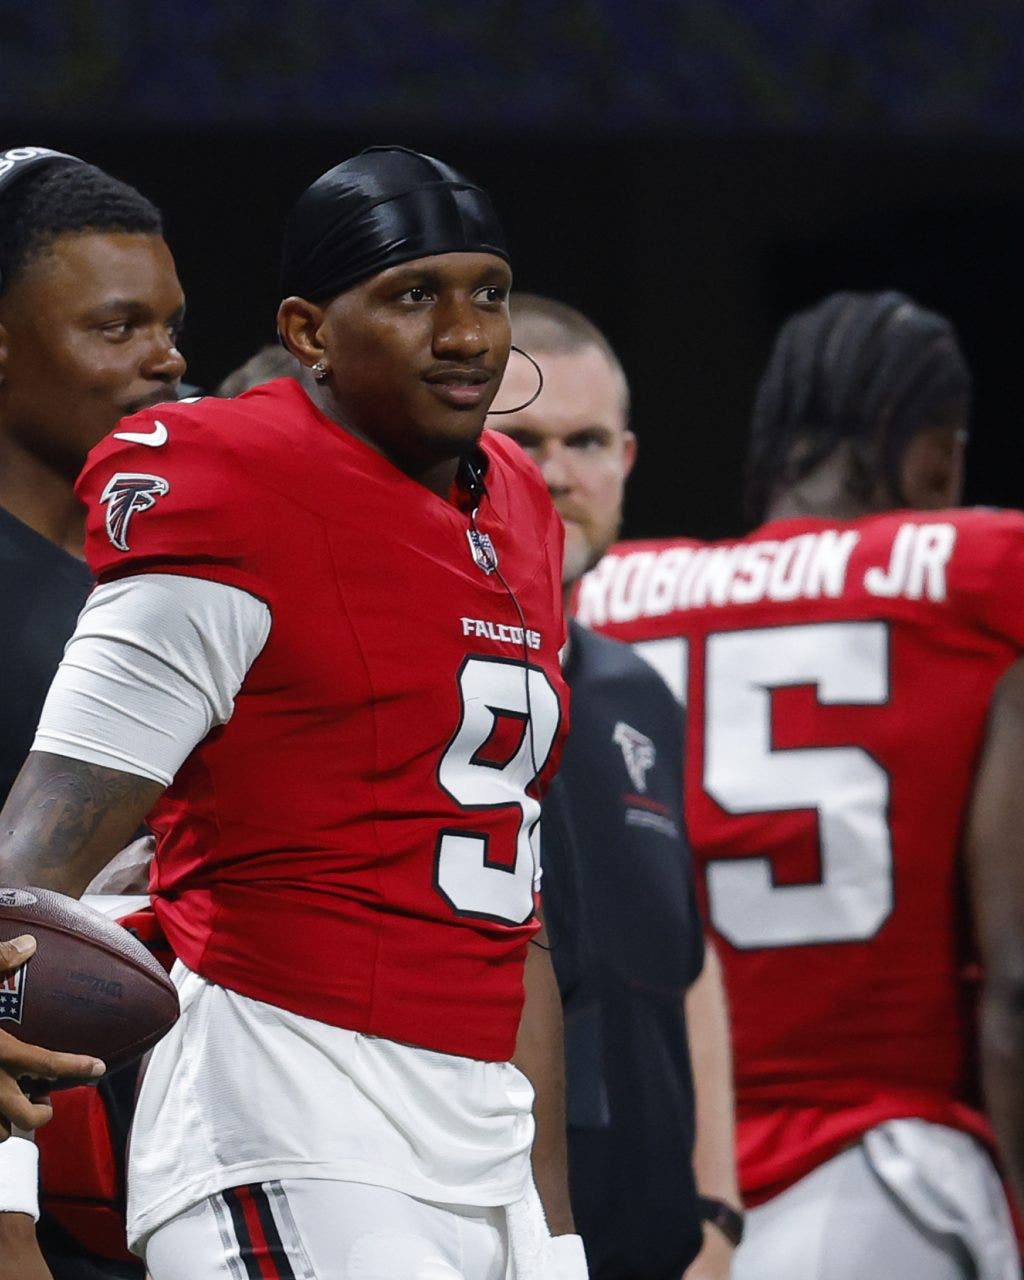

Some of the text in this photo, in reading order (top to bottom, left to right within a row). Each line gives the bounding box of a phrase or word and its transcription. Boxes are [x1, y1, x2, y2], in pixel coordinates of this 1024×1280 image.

[460, 617, 541, 650] FALCONS
[863, 522, 958, 603] JR
[434, 653, 562, 926] 9
[632, 619, 894, 950] 5
